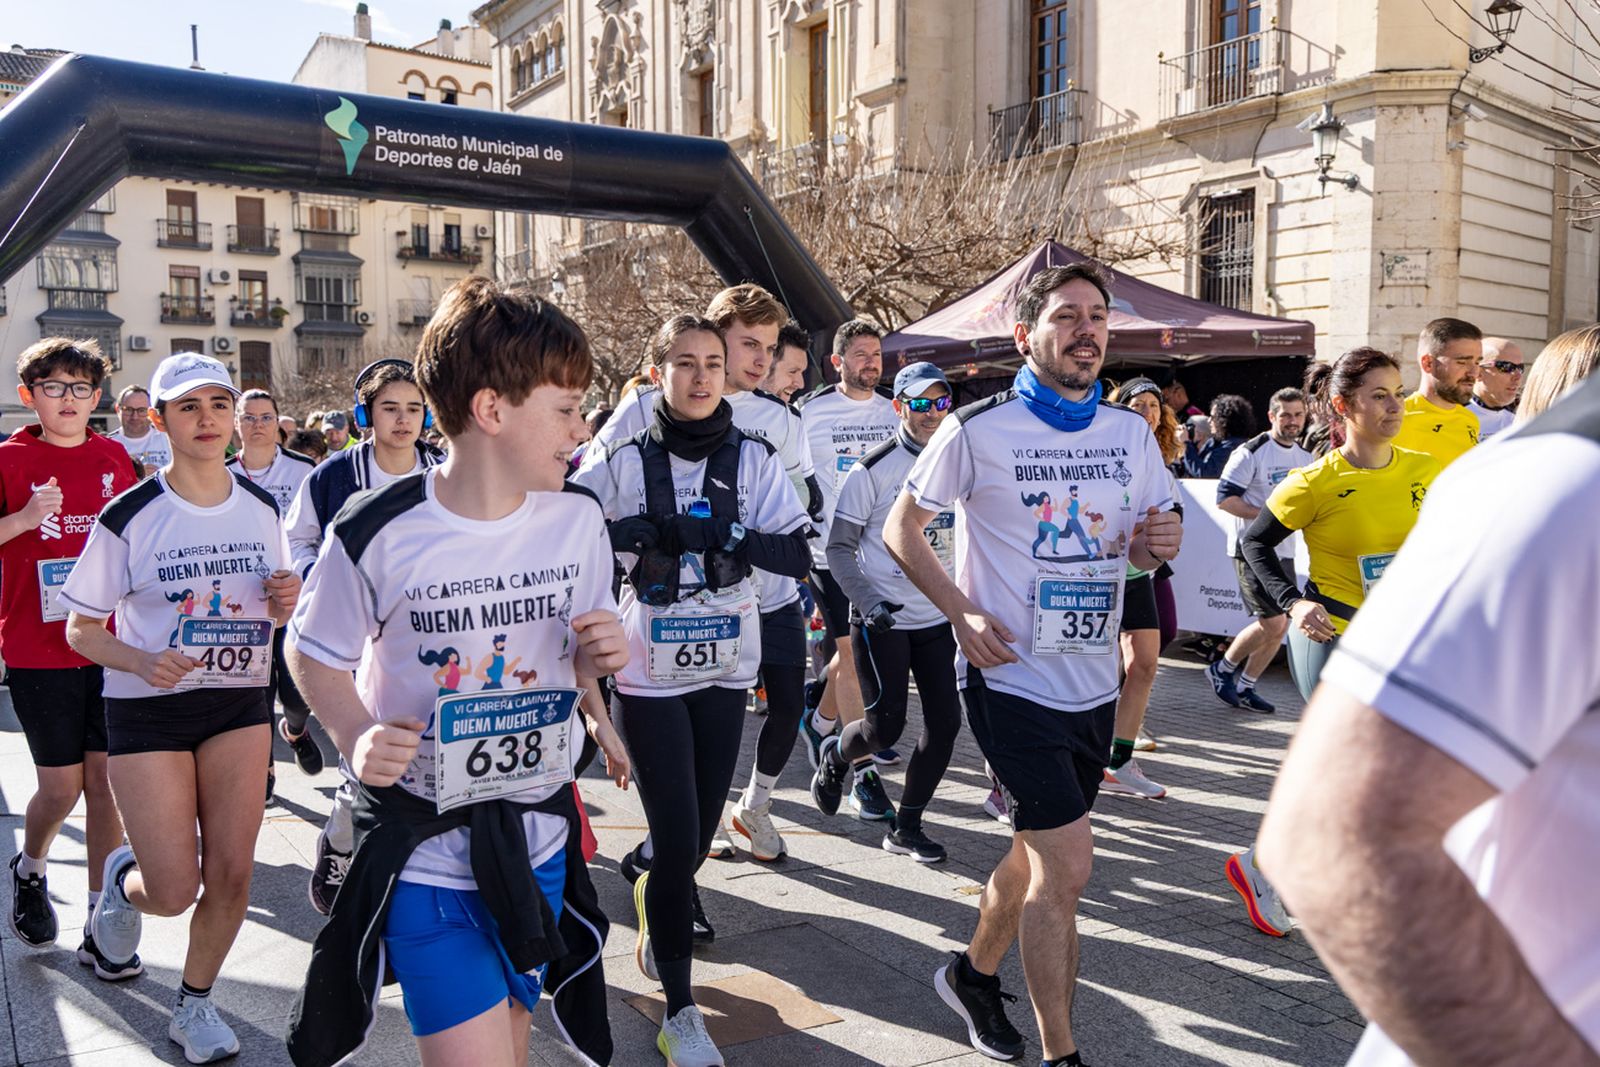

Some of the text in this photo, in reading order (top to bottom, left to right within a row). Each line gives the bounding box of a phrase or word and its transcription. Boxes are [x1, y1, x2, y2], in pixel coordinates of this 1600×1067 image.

[375, 126, 564, 162] Patronato Municipal de
[375, 145, 522, 176] Deportes de Jaén
[832, 433, 884, 443] BUENA MUERTE
[1012, 447, 1128, 459] VI CARRERA CAMINATA
[1015, 464, 1111, 482] BUENA MUERTE
[155, 542, 265, 562] VI CARRERA CAMINATA
[158, 557, 253, 582] BUENA MUERTE
[404, 588, 421, 601] VI
[427, 576, 505, 599] CARRERA
[1200, 585, 1236, 597] Patronato
[1050, 595, 1107, 607] BUENA MUERTE
[1207, 597, 1243, 611] Deportes
[410, 594, 557, 634] BUENA MUERTE
[669, 619, 699, 627] CARRERA
[700, 617, 731, 626] CAMINATA
[661, 628, 717, 640] BUENA MUERTE
[1062, 611, 1109, 639] 357
[192, 632, 248, 643] BUENA MUERTE
[200, 647, 253, 671] 409
[675, 642, 717, 668] 651
[454, 693, 561, 714] VI CARRERA CAMINATA
[453, 709, 539, 736] BUENA MUERTE
[466, 730, 542, 778] 638
